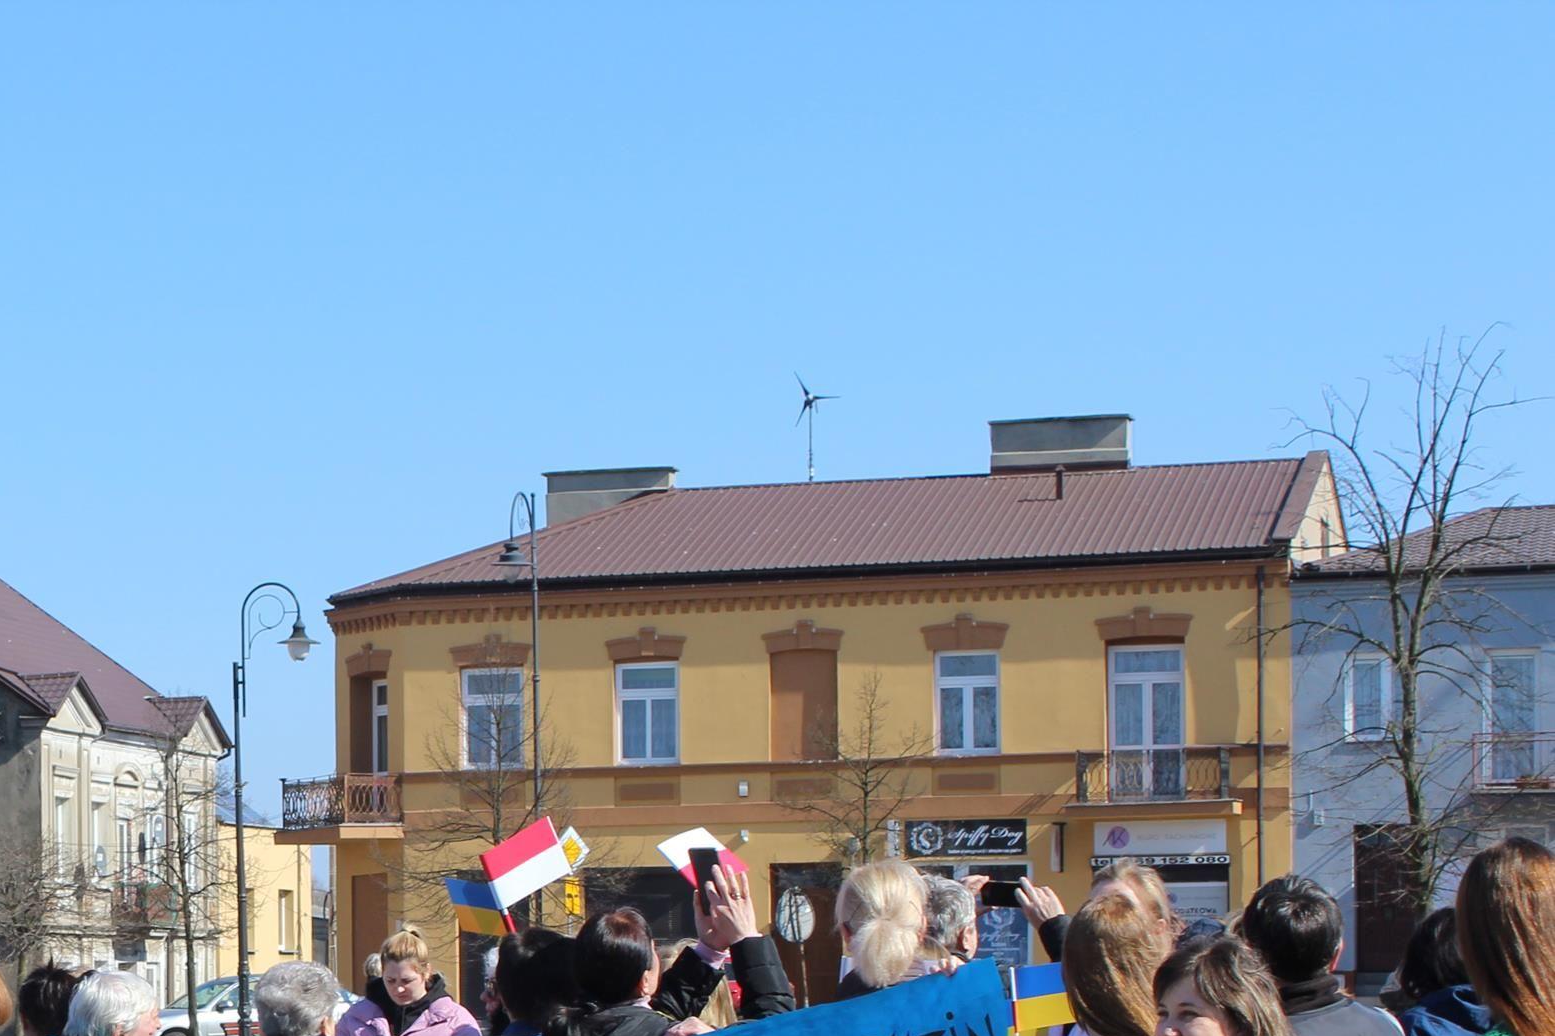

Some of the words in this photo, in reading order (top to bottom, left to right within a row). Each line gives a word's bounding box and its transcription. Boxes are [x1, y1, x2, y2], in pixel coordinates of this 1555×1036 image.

[947, 825, 989, 846] Spiffy
[990, 826, 1024, 846] Dog
[1160, 856, 1189, 864] 152
[1195, 855, 1227, 864] 080
